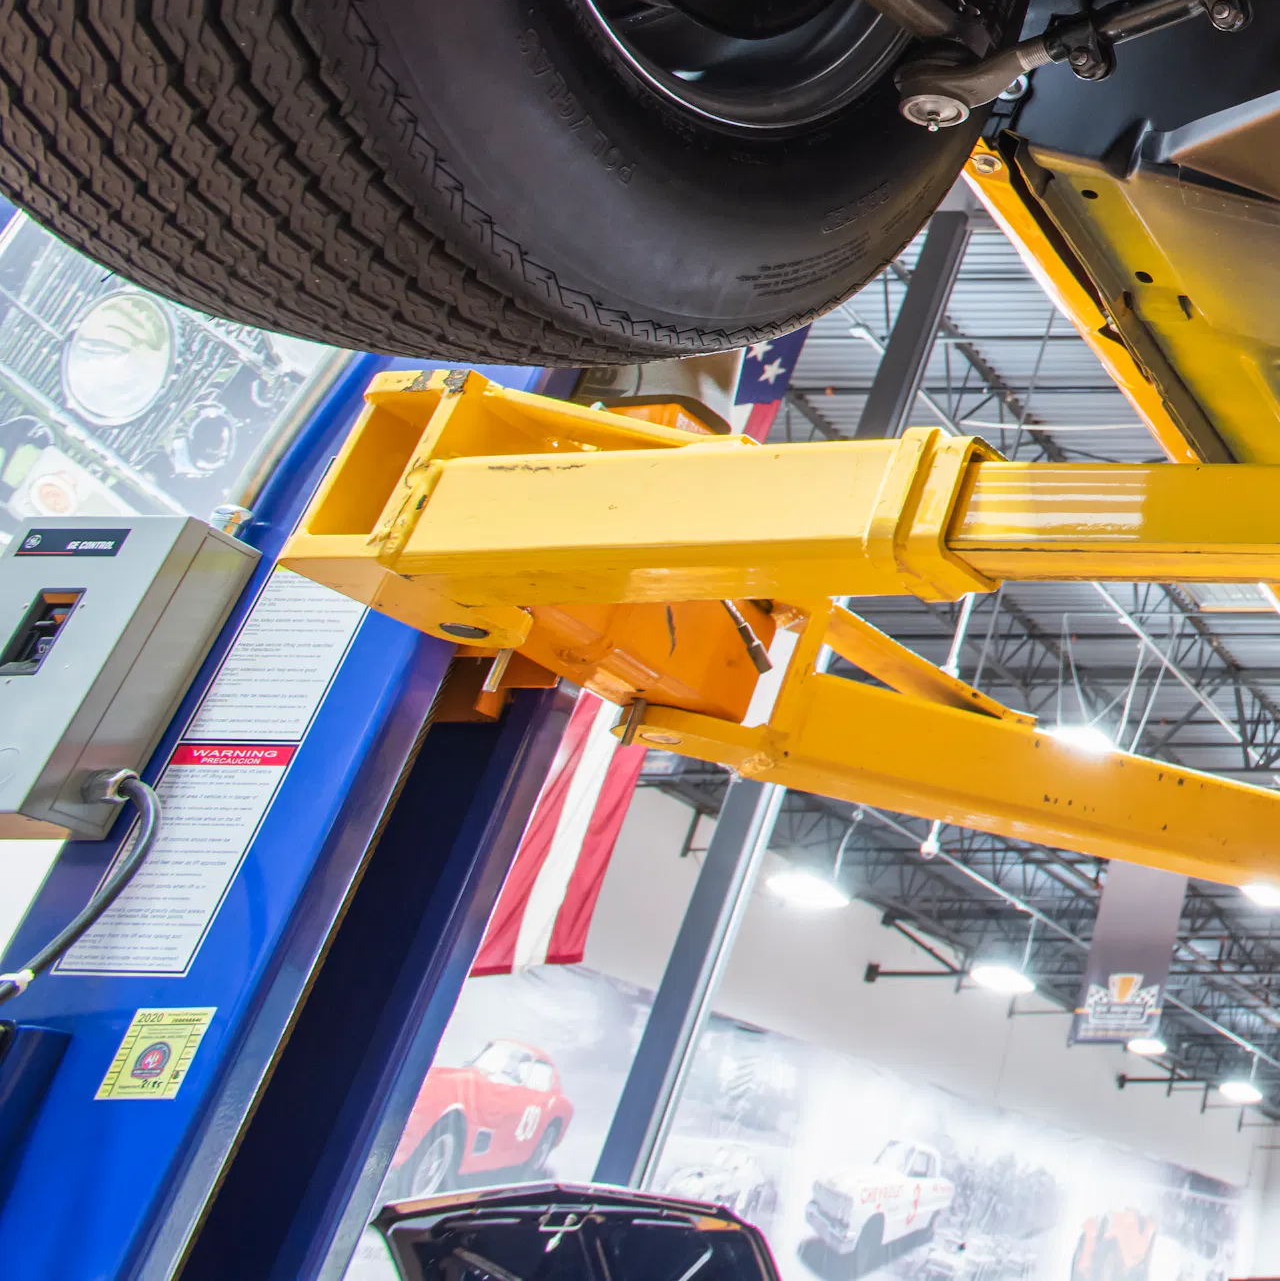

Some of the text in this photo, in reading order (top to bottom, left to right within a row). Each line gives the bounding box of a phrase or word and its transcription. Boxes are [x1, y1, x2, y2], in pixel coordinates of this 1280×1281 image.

[66, 541, 115, 550] GE CONTROL
[193, 749, 278, 758] WARNING
[137, 1013, 165, 1023] 2020
